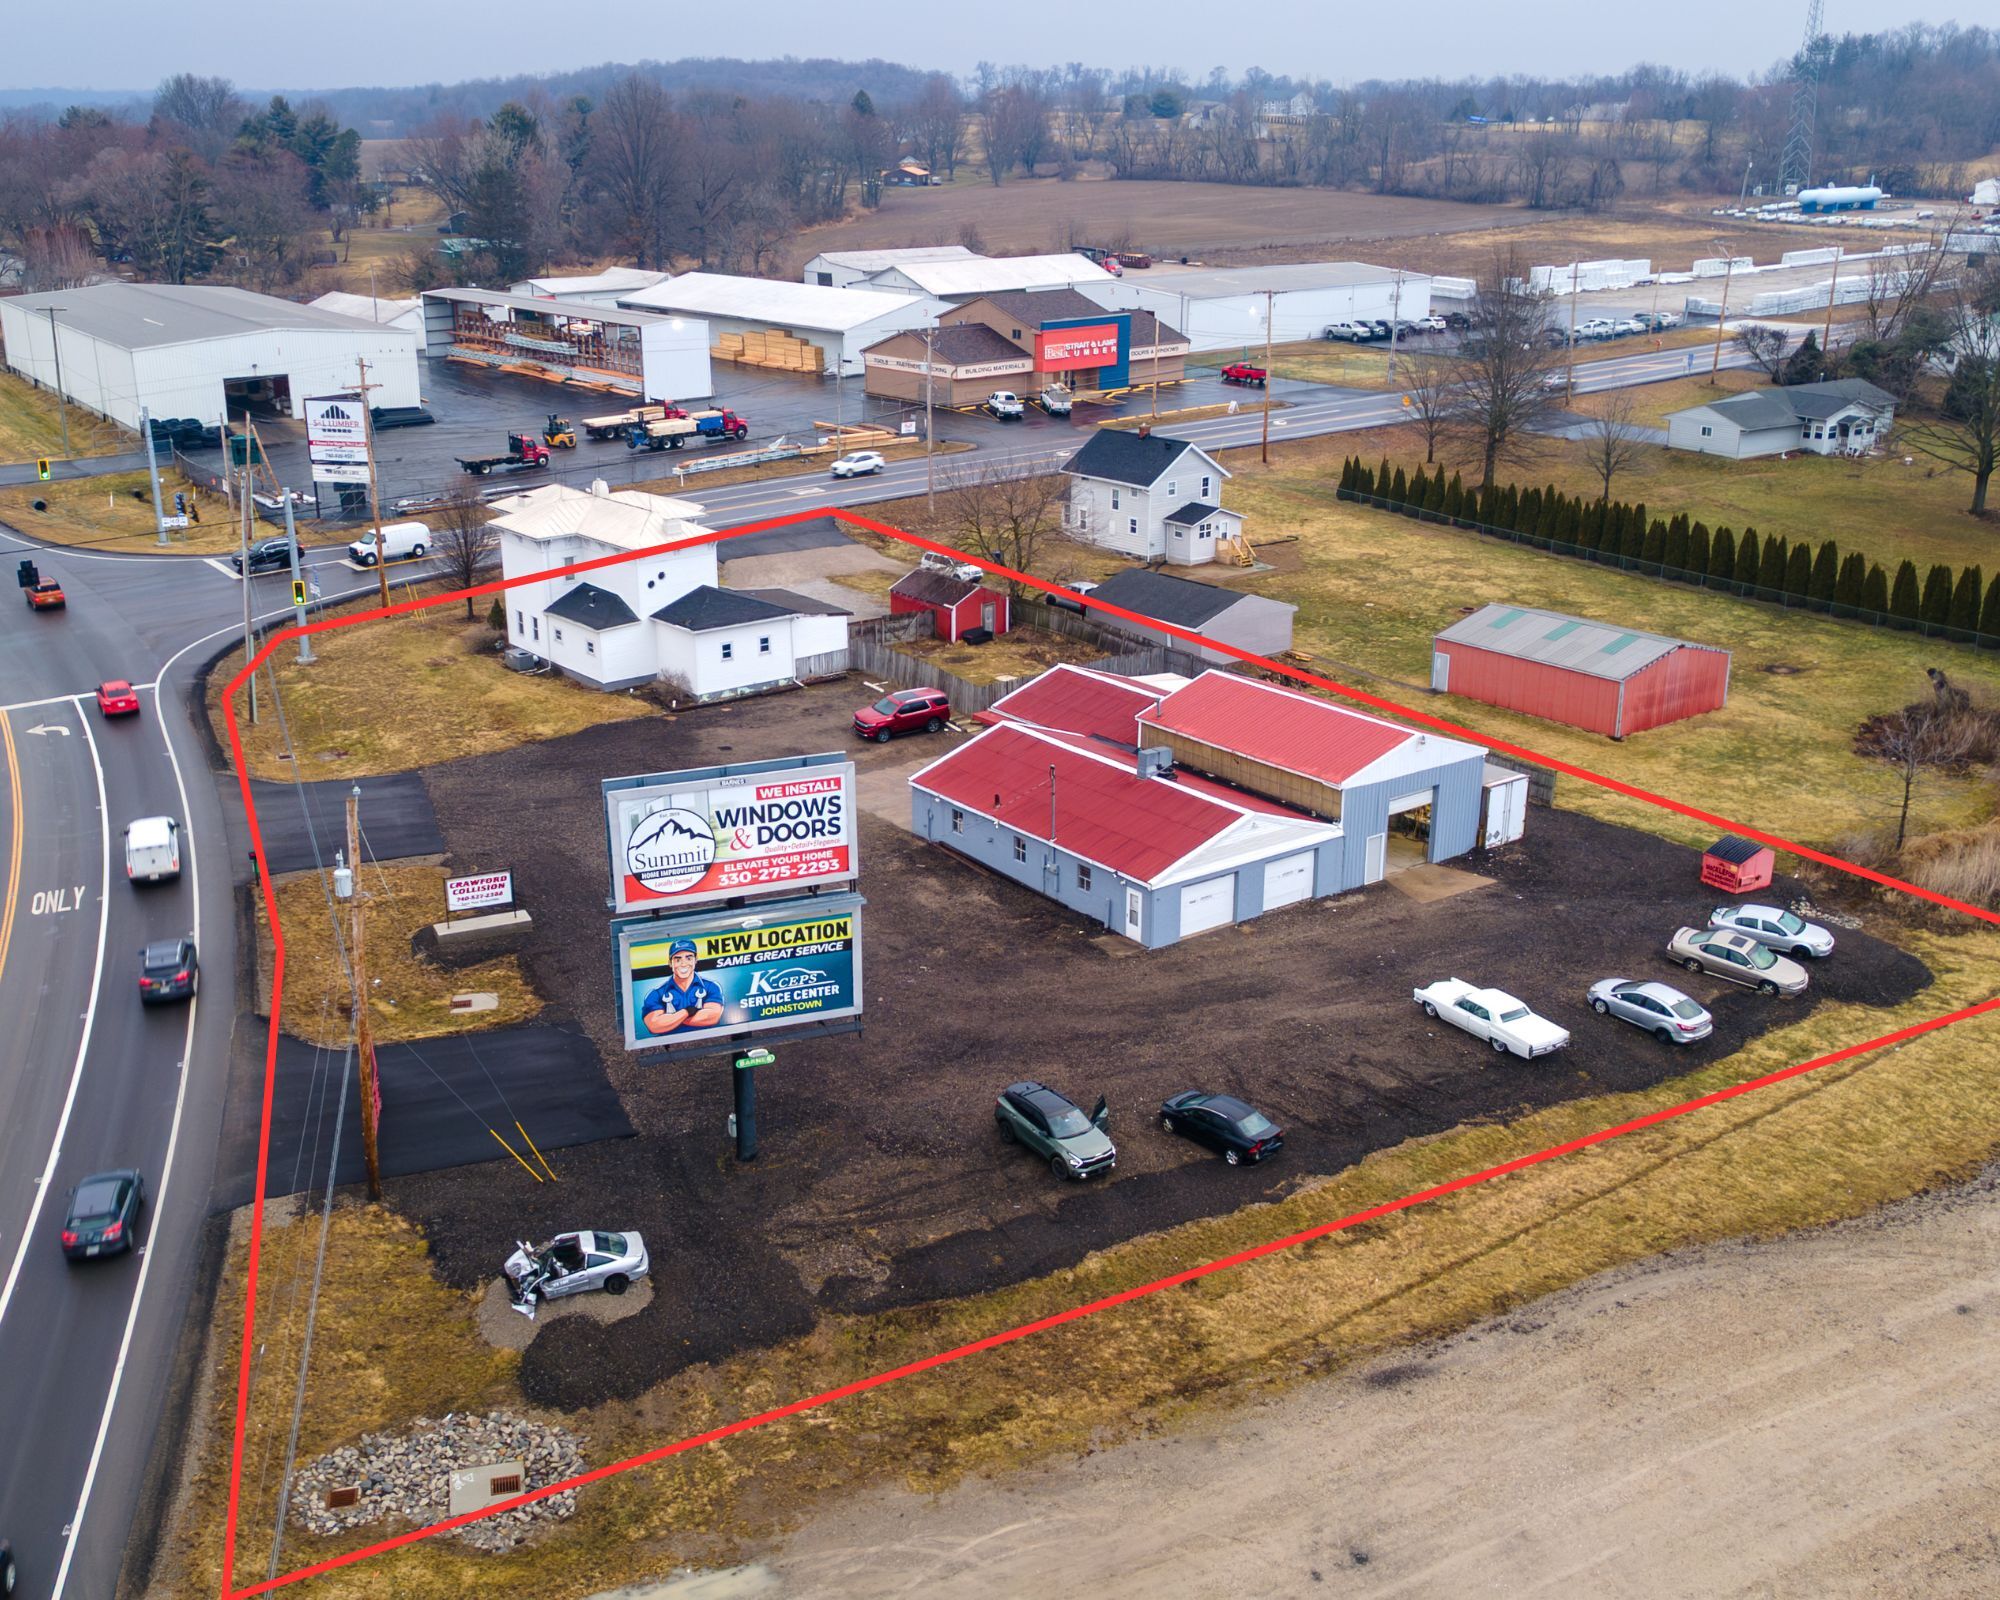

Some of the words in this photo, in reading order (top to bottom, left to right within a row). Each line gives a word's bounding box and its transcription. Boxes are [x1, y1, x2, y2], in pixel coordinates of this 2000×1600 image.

[1065, 341, 1090, 351] STRAIT
[1091, 340, 1097, 348] &
[1065, 346, 1117, 357] LUMBER
[965, 366, 992, 375] BUILDING
[993, 362, 1026, 372] MATERIALS
[759, 788, 783, 799] WE
[785, 780, 838, 796] INSTALL
[715, 795, 841, 829] WINDOWS
[730, 828, 753, 851] &
[757, 817, 841, 845] DOORS
[635, 845, 709, 870] Summit
[724, 860, 769, 872] ELEVATE
[771, 854, 800, 865] YOUR
[802, 850, 833, 861] HOME
[449, 875, 508, 889] CRAWFORD
[641, 872, 660, 880] HOME
[660, 865, 705, 877] IMPROVEMENT
[718, 859, 840, 886] 330-275-2293
[31, 885, 86, 915] ONLY
[453, 882, 506, 896] COLLISION
[707, 934, 752, 956] NEW
[758, 921, 848, 949] LOCATION
[716, 954, 751, 968] SAME
[754, 948, 793, 962] GREAT
[796, 941, 844, 956] SERVICE
[745, 968, 818, 996] K-CEPS
[740, 991, 791, 1008] SERVICE
[793, 984, 840, 1000] CENTER
[760, 999, 822, 1016] JOHNSTOWN
